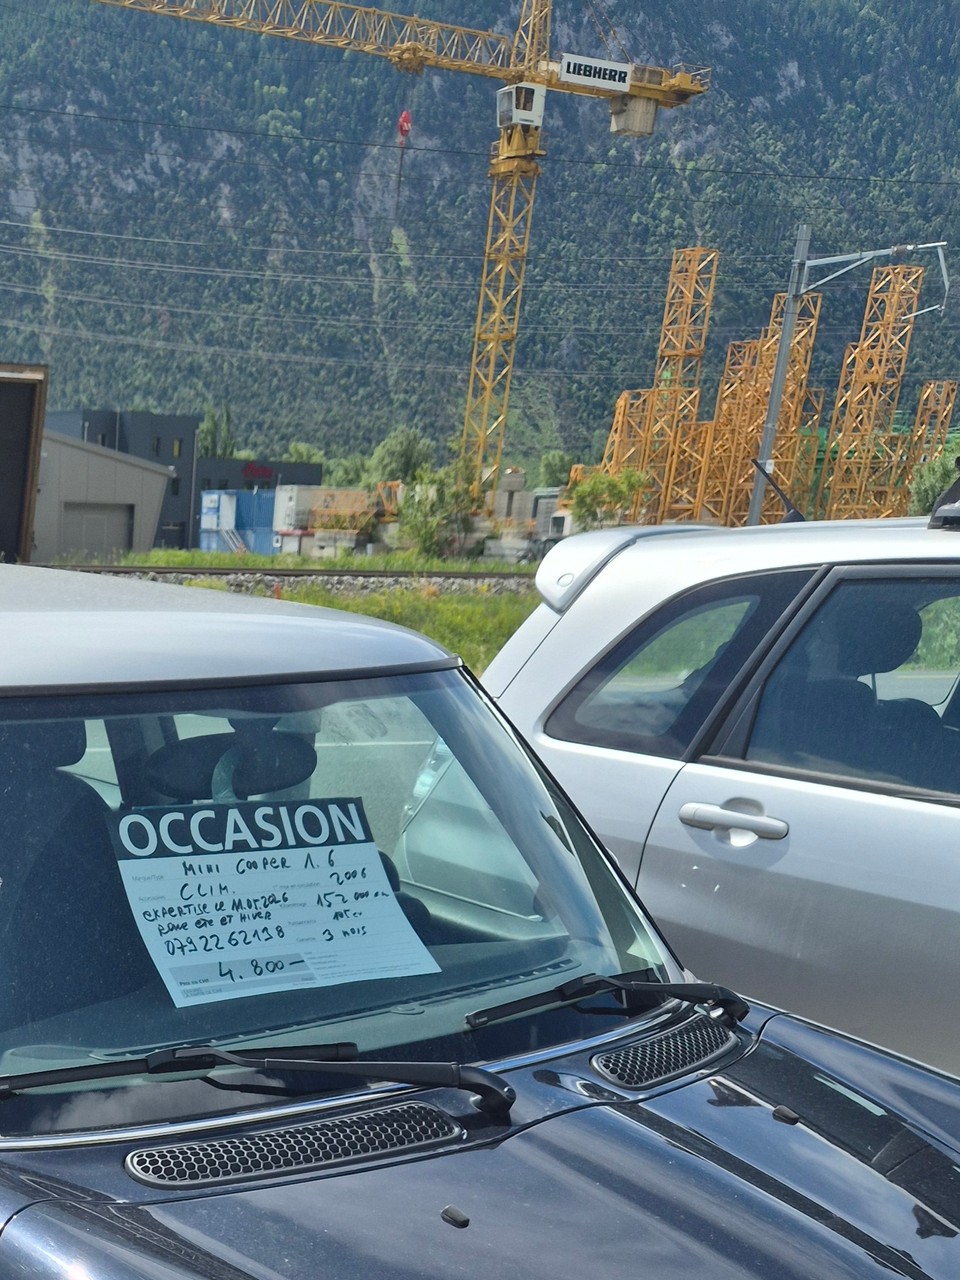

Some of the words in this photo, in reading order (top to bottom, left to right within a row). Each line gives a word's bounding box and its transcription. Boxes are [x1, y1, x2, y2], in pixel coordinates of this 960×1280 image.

[566, 61, 628, 83] LIEBHERR
[118, 803, 366, 856] OCCASION
[182, 861, 220, 876] MINI
[329, 867, 367, 886] 2006
[317, 892, 348, 908] 152
[322, 928, 334, 942] 3
